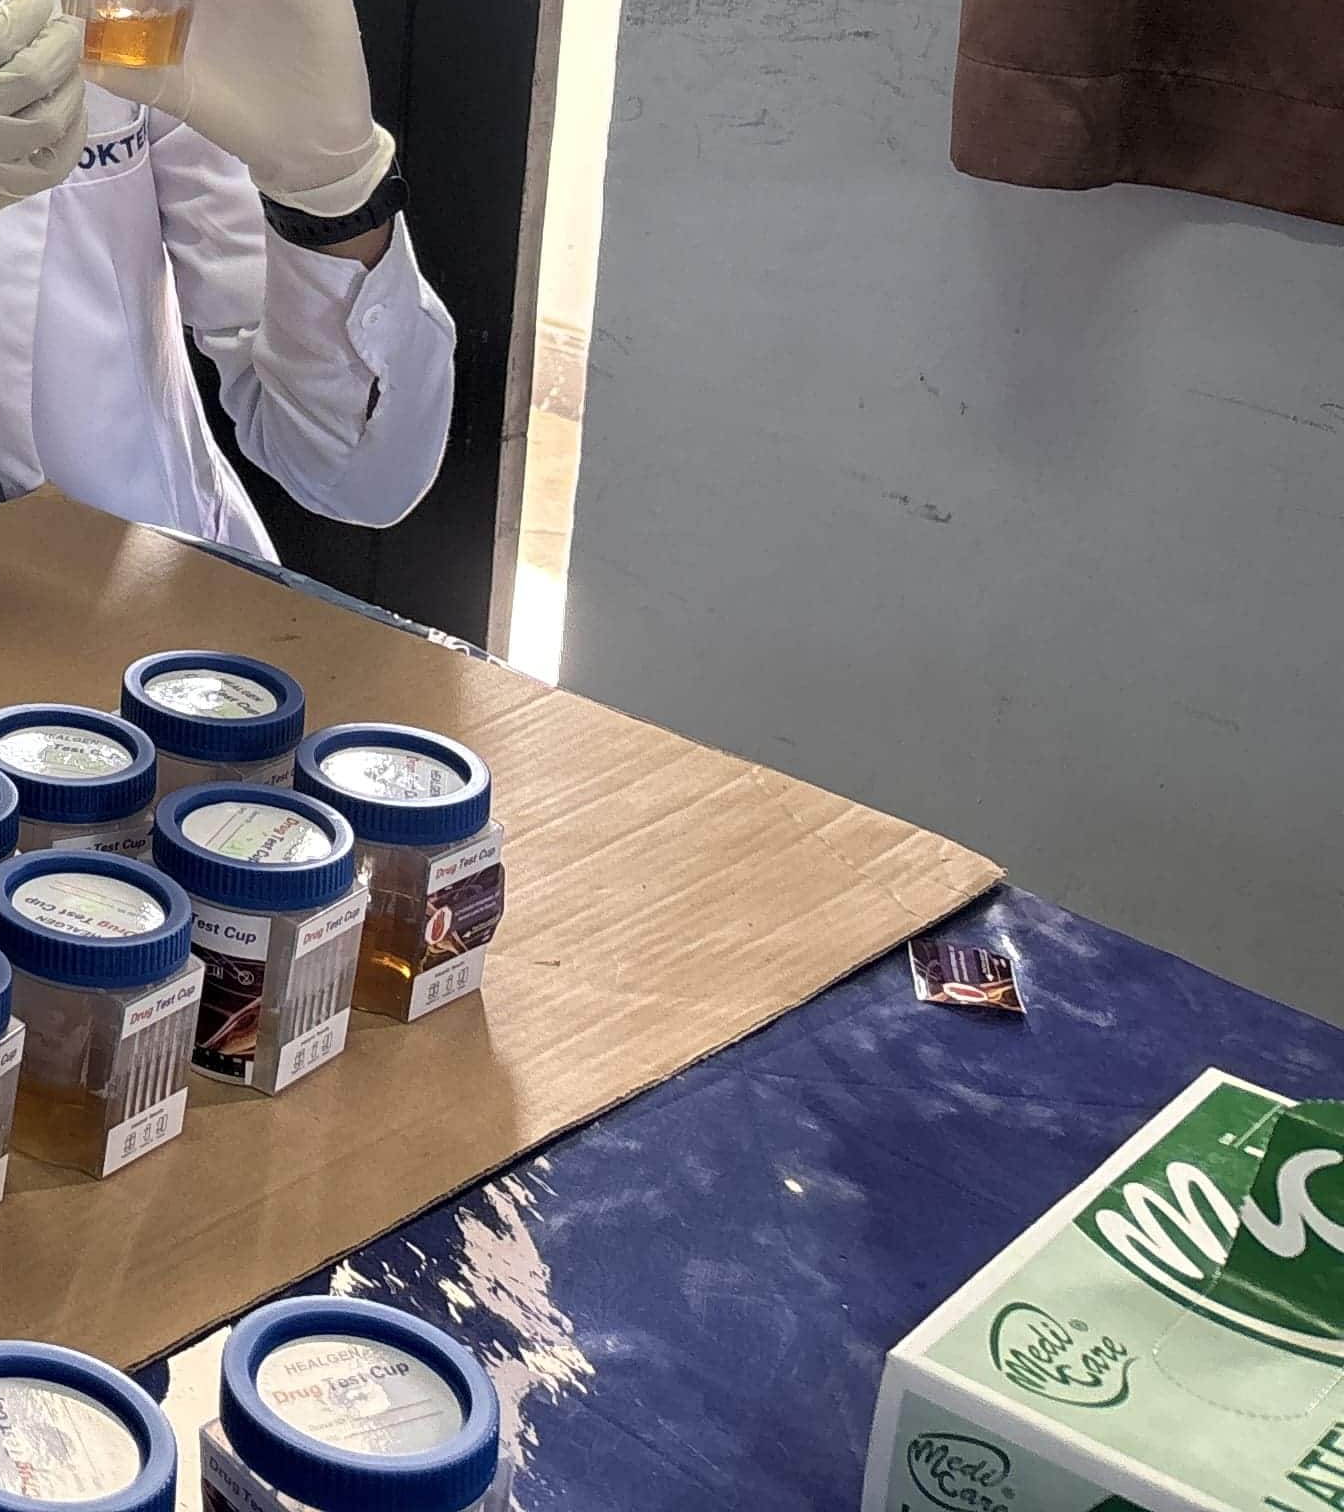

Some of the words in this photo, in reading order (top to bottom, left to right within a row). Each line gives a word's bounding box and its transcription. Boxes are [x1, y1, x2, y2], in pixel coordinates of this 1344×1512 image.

[78, 124, 145, 169] OKTE
[275, 817, 300, 837] Drug
[122, 839, 146, 850] Cup
[459, 854, 478, 870] Test
[478, 846, 496, 861] Cup
[24, 895, 52, 907] Cup
[58, 907, 94, 924] Test
[325, 917, 344, 933] Test
[344, 908, 361, 924] Cup
[224, 925, 257, 944] Cup
[129, 1005, 154, 1025] Drug
[156, 994, 176, 1013] Test
[176, 985, 195, 1002] Cup
[284, 1347, 360, 1375] HEALGEN
[1005, 1319, 1072, 1390] Medi
[1049, 1333, 1128, 1389] Care
[271, 1383, 321, 1406] Drug
[328, 1373, 367, 1392] Test
[369, 1361, 410, 1380] Cup
[209, 1456, 239, 1495] Drug
